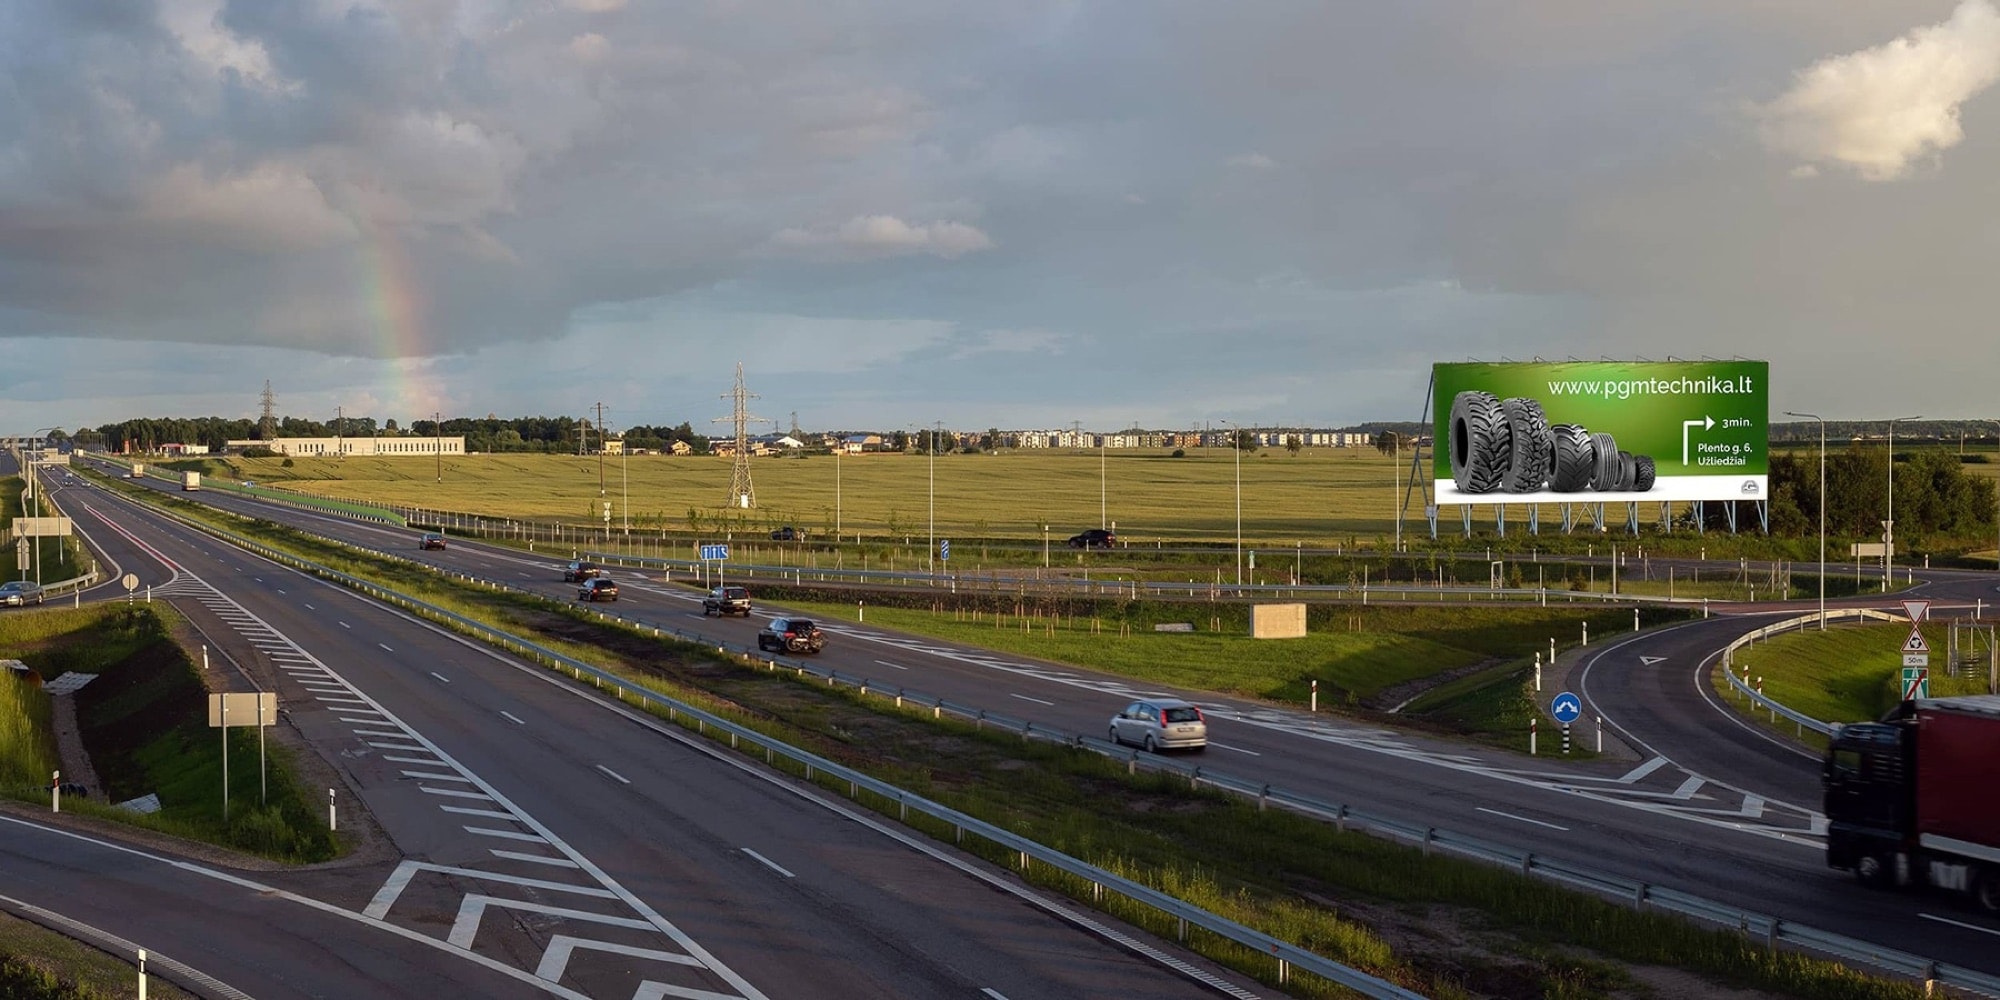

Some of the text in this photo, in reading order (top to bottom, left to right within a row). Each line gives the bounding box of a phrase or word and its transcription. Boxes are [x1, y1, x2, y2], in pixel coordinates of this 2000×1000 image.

[1548, 376, 1752, 399] www.pgmtechnika.lt
[1698, 443, 1730, 452] Plento
[1732, 444, 1741, 455] g.
[1698, 456, 1746, 465] Užliedžiai
